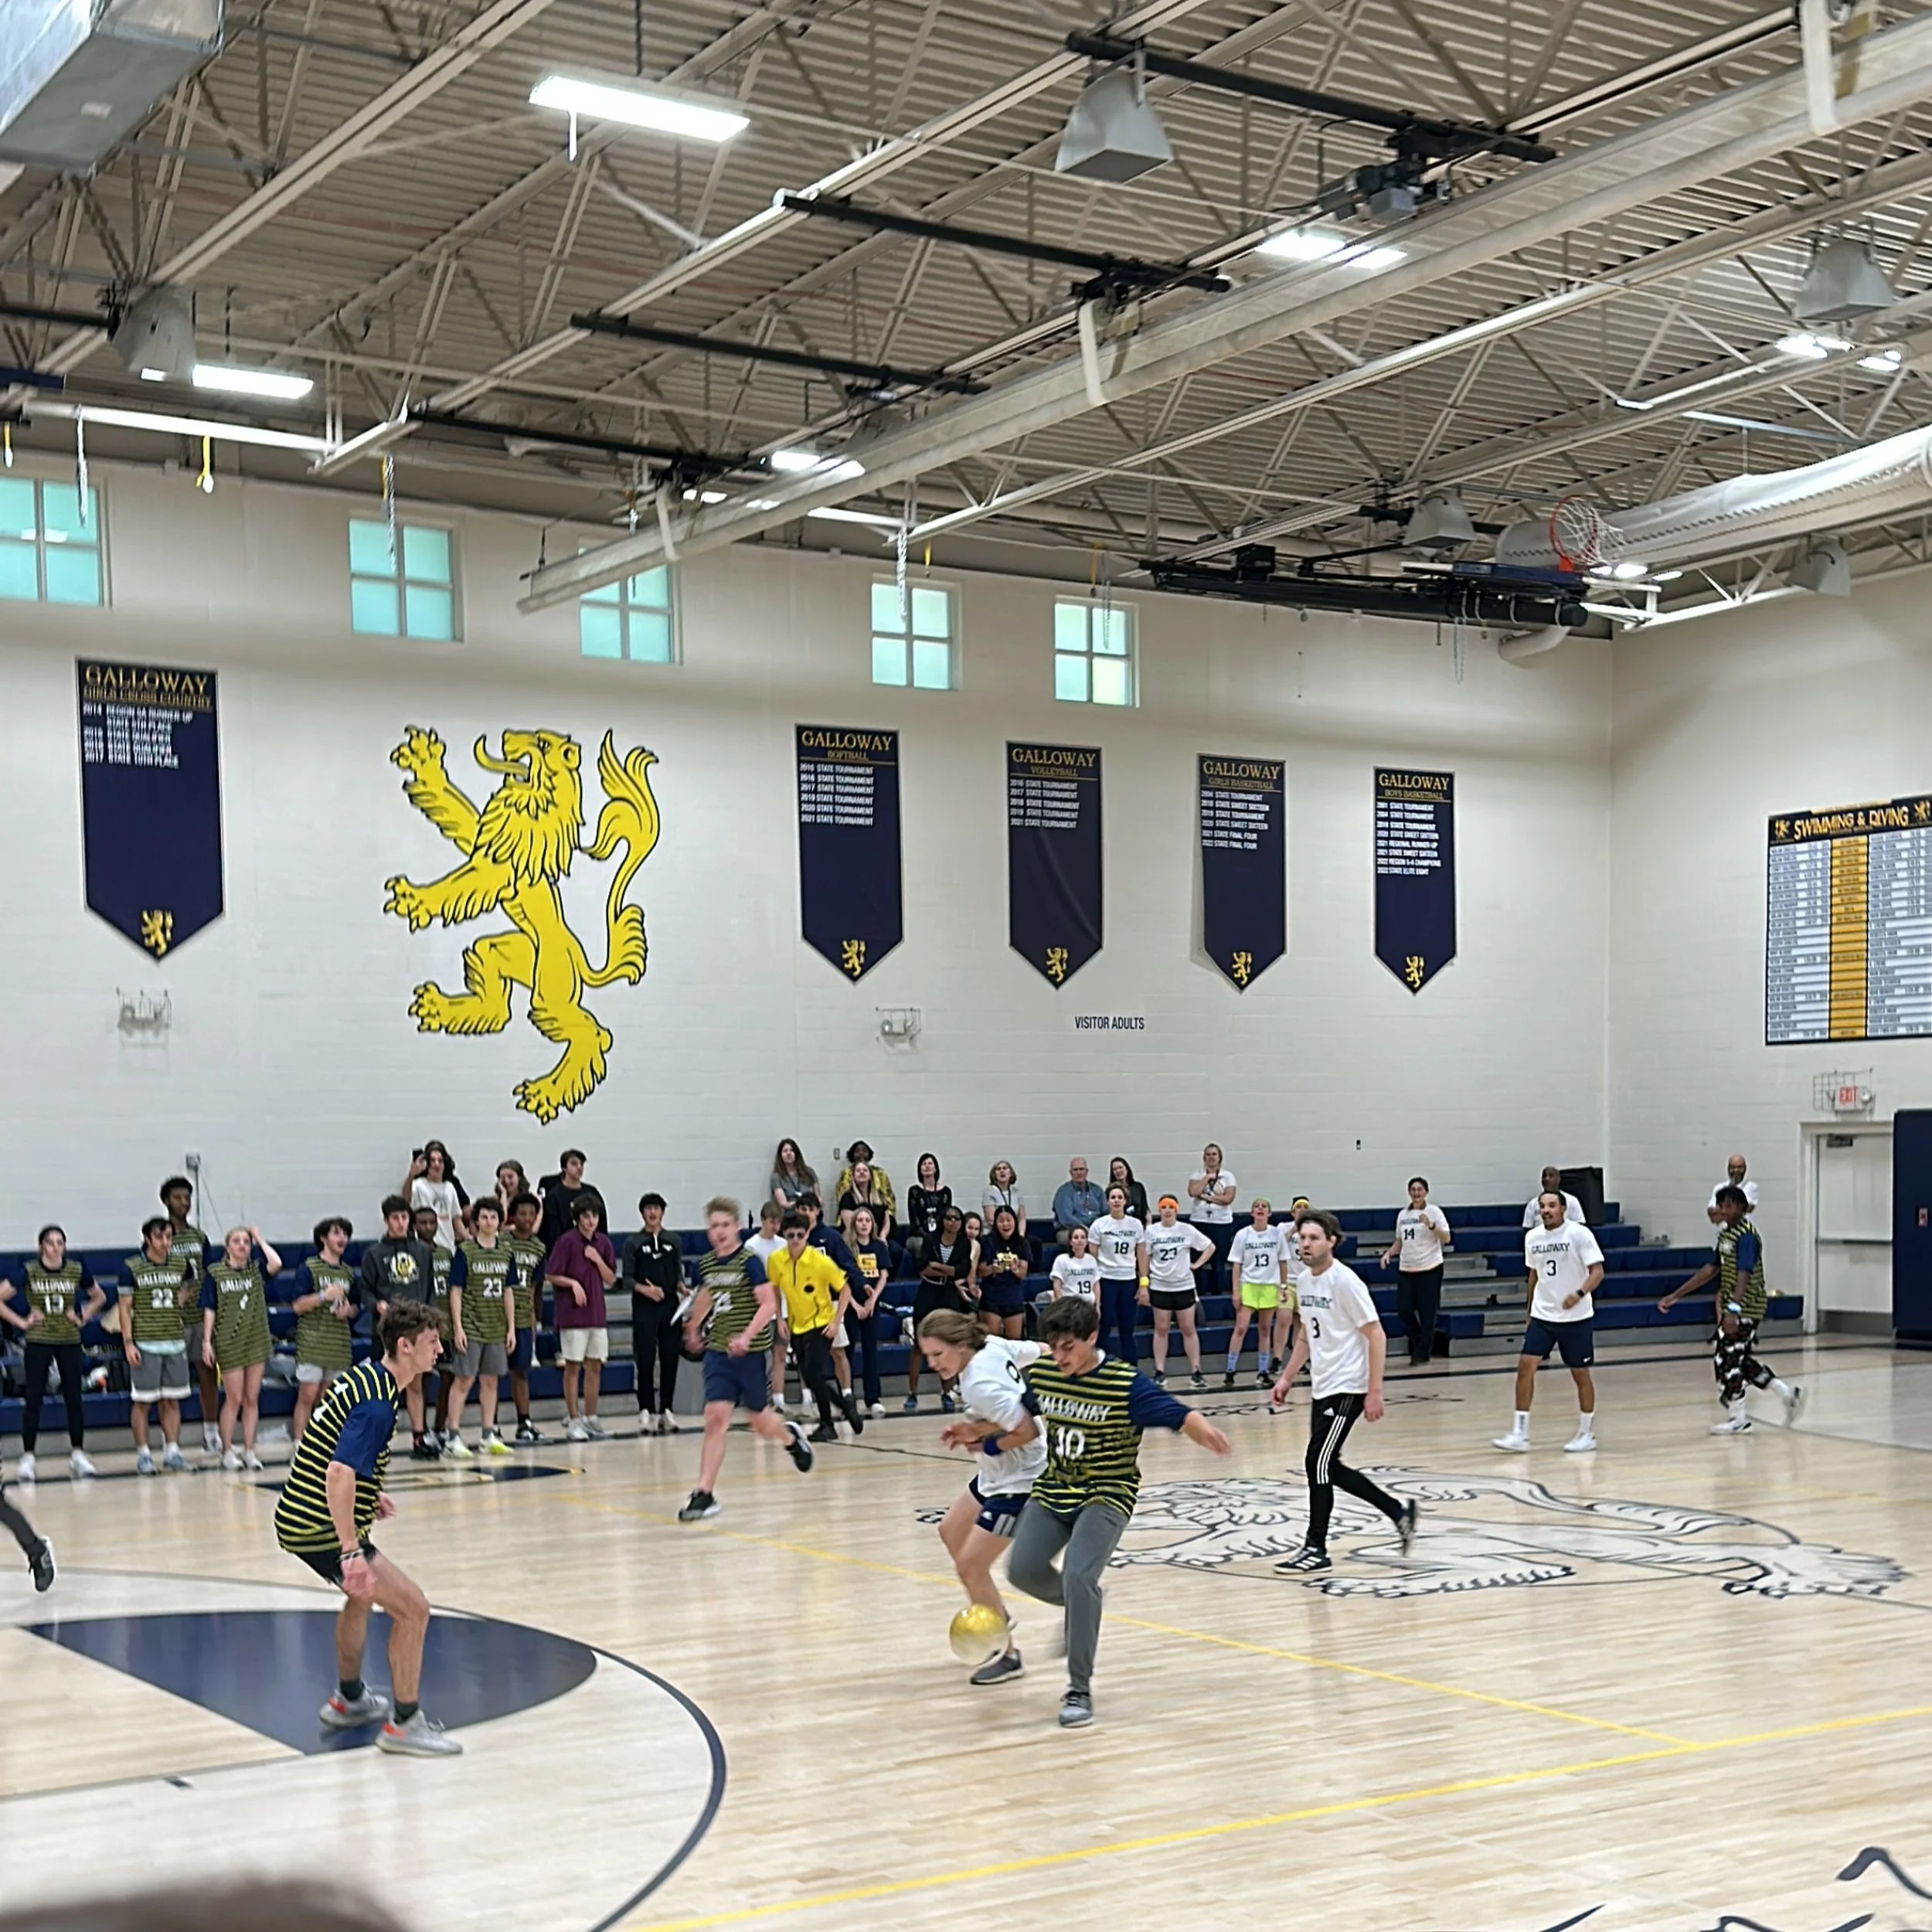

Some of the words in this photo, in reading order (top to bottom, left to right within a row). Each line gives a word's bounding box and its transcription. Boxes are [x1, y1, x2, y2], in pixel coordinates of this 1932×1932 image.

[85, 665, 207, 693] GALLOWAY
[801, 730, 893, 751] GALLOWAY
[828, 750, 869, 760] SOFTBALL
[1012, 748, 1096, 767] GALLOWAY
[817, 764, 834, 773] STATE
[835, 765, 873, 774] TOURNAMENT
[1030, 766, 1078, 777] VOLLEYBALL
[1203, 760, 1280, 779] GALLOWAY
[817, 774, 834, 784] STATE
[835, 775, 874, 784] TOURNAMENT
[1209, 777, 1230, 786] GIRLS
[1231, 778, 1274, 790] BASKETBALL
[1379, 773, 1449, 790] GALLOWAY
[817, 784, 835, 793] STATE
[836, 785, 874, 794] TOURNAMENT
[1384, 789, 1403, 798] BOYS
[1403, 790, 1444, 800] BASKETBALL
[816, 794, 834, 803] STATE
[835, 794, 873, 804] TOURNAMENT
[816, 804, 834, 813] STATE
[835, 805, 873, 815] TOURNAMENT
[816, 815, 834, 824] STATE
[835, 815, 873, 825] TOURNAMENT
[1794, 813, 1854, 840] SWIMMING
[1857, 811, 1866, 826] &
[1869, 806, 1909, 827] DIVING
[1075, 1016, 1110, 1029] VISITOR
[1111, 1016, 1145, 1029] ADULTS
[1403, 1228, 1415, 1240] 14
[1114, 1242, 1129, 1254] 18
[1245, 1241, 1277, 1250] GALLOWAY
[1531, 1243, 1570, 1254] GALLOWAY
[1160, 1247, 1177, 1261] 23
[1254, 1254, 1269, 1267] 13
[1546, 1259, 1556, 1276] 3
[137, 1271, 182, 1289] GALLOWAY
[483, 1277, 502, 1299] 23
[1077, 1281, 1091, 1294] 19
[151, 1287, 174, 1309] 22
[1038, 1395, 1111, 1421] GALLOWAY
[1056, 1427, 1085, 1461] 10
